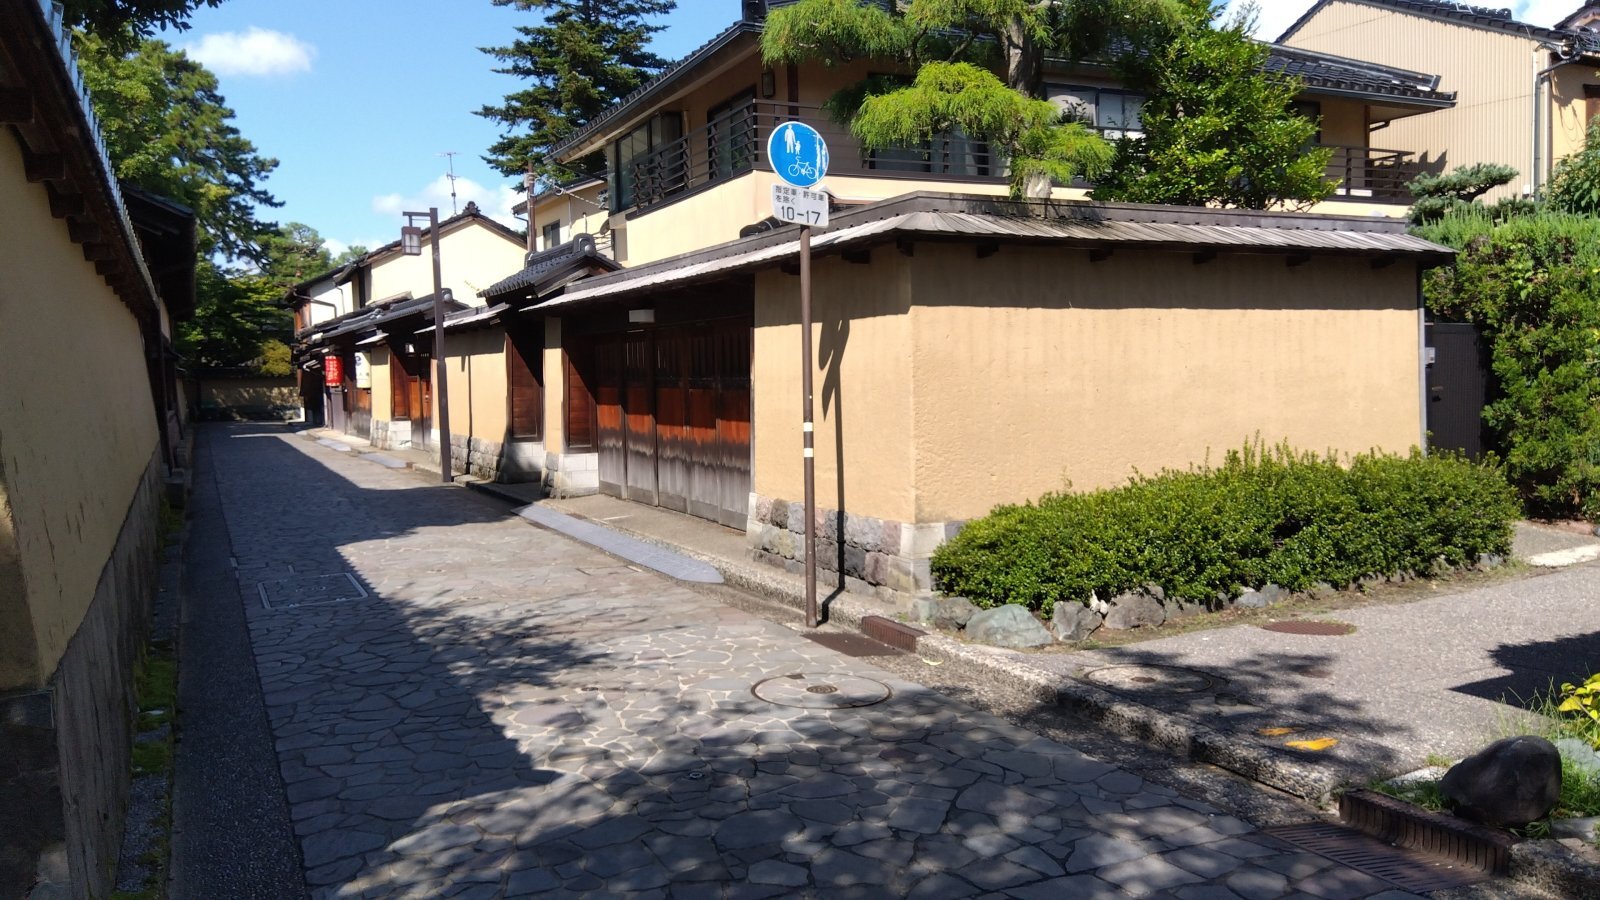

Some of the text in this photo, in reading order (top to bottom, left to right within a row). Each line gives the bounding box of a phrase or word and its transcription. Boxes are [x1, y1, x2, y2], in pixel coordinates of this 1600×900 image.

[775, 194, 795, 205] を除く
[781, 205, 821, 225] 10-17
